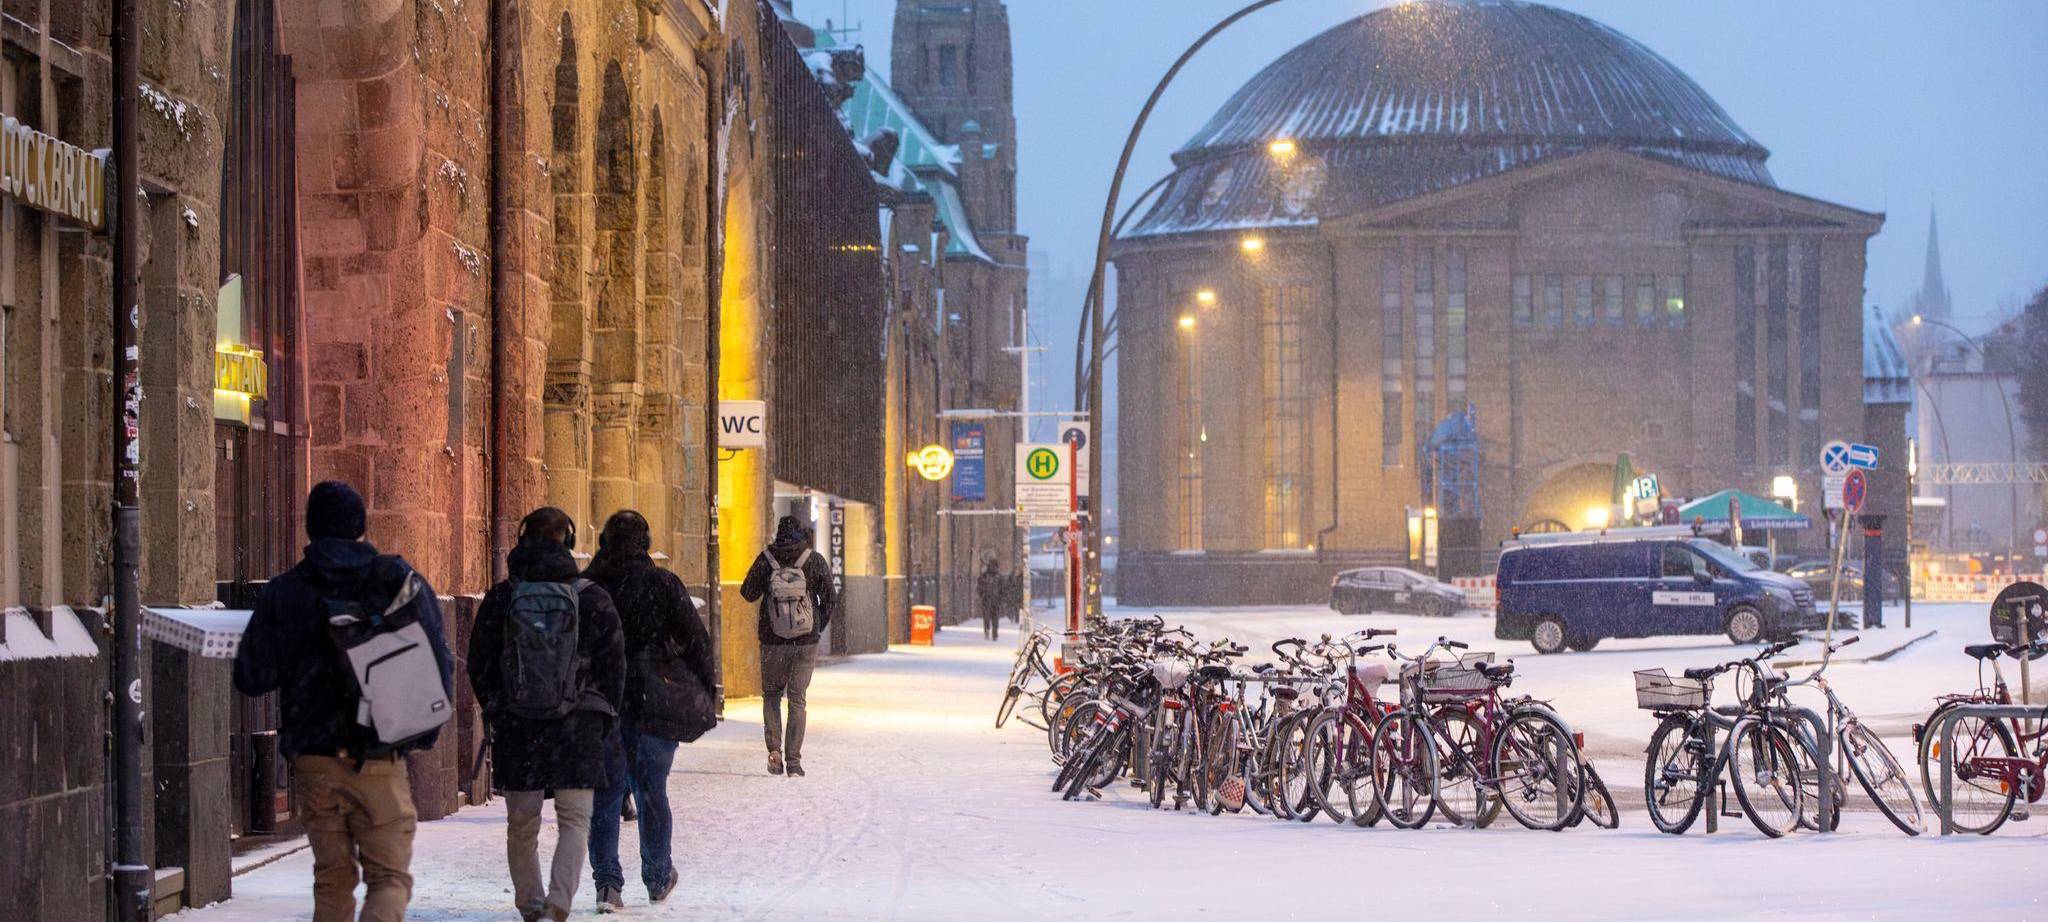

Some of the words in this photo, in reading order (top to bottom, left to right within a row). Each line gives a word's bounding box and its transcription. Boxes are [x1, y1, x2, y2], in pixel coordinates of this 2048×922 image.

[721, 415, 760, 433] WC
[1035, 455, 1051, 473] H
[831, 526, 842, 594] AUTOMAT
